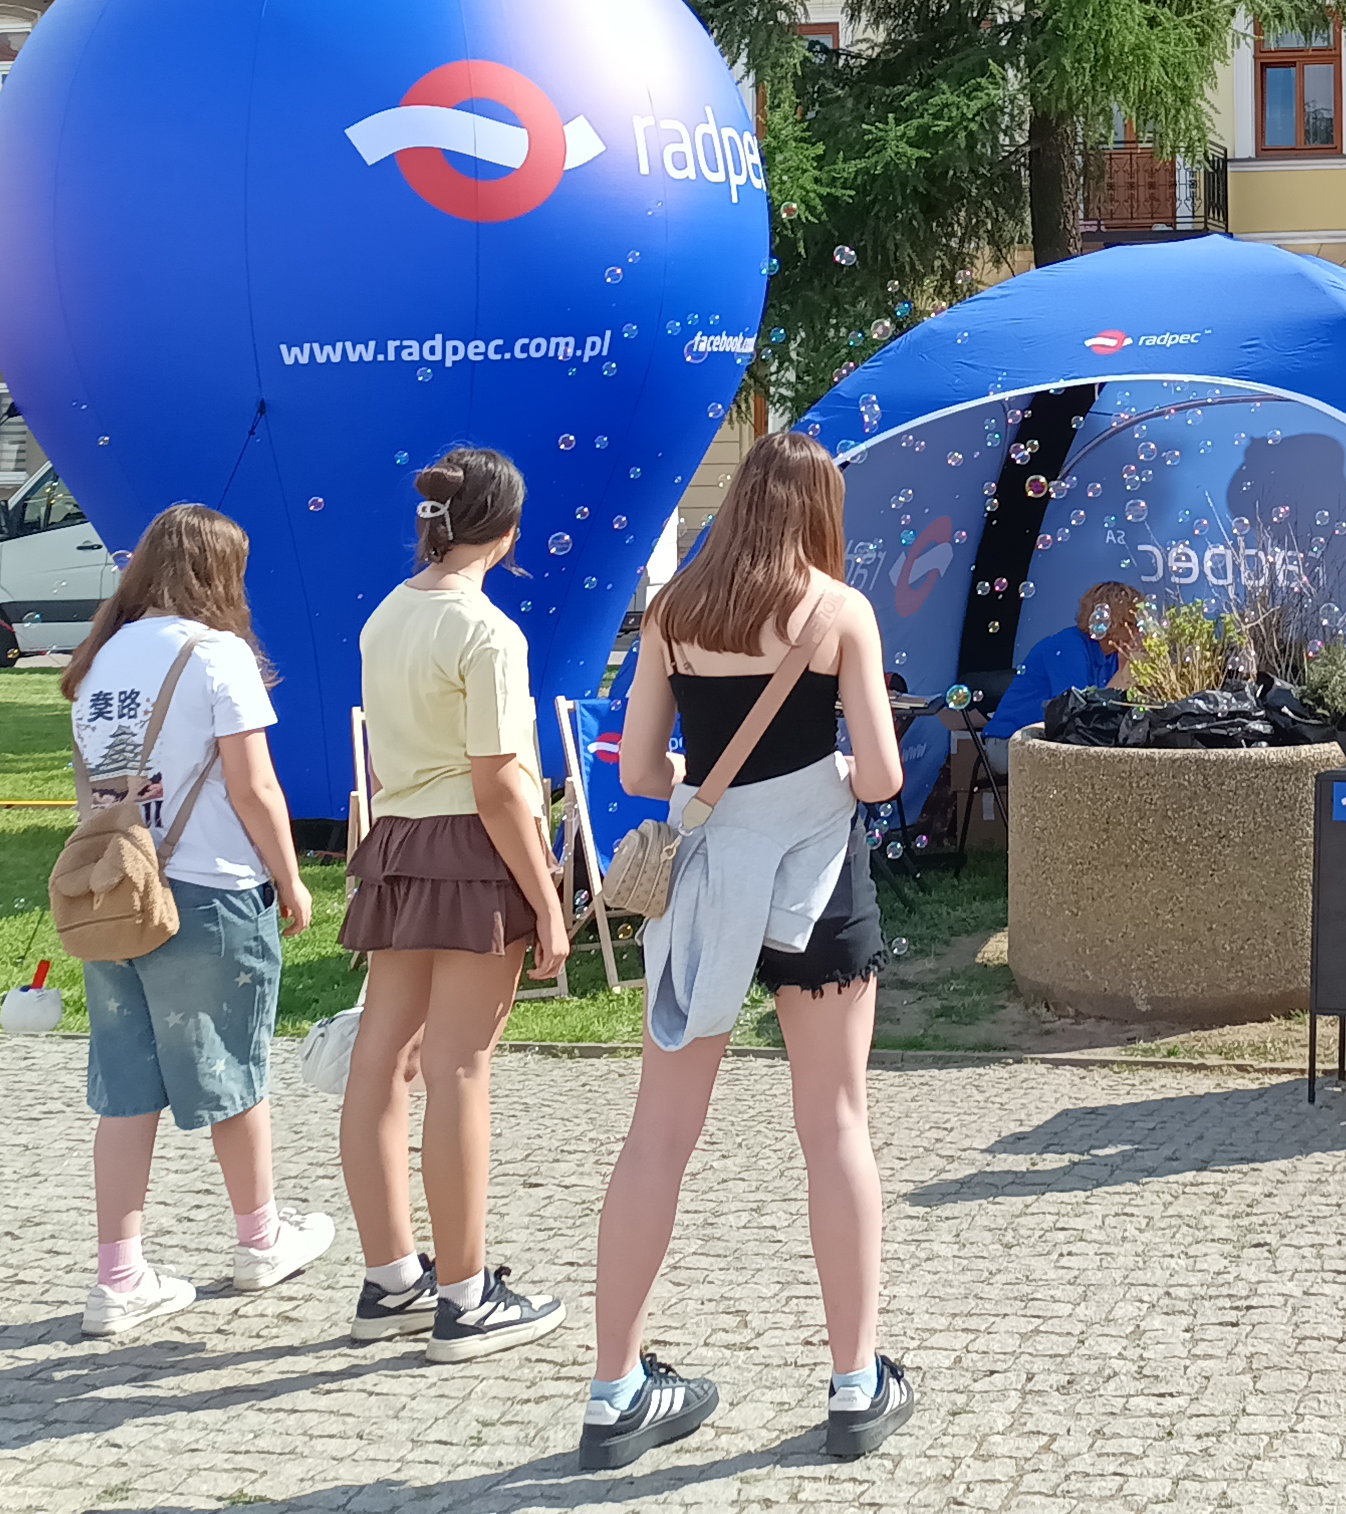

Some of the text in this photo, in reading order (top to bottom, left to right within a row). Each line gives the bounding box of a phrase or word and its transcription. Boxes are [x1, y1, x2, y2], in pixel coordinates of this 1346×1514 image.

[632, 105, 766, 204] radpe
[280, 330, 611, 367] www.radpec.com.pl
[1138, 332, 1201, 348] radpec
